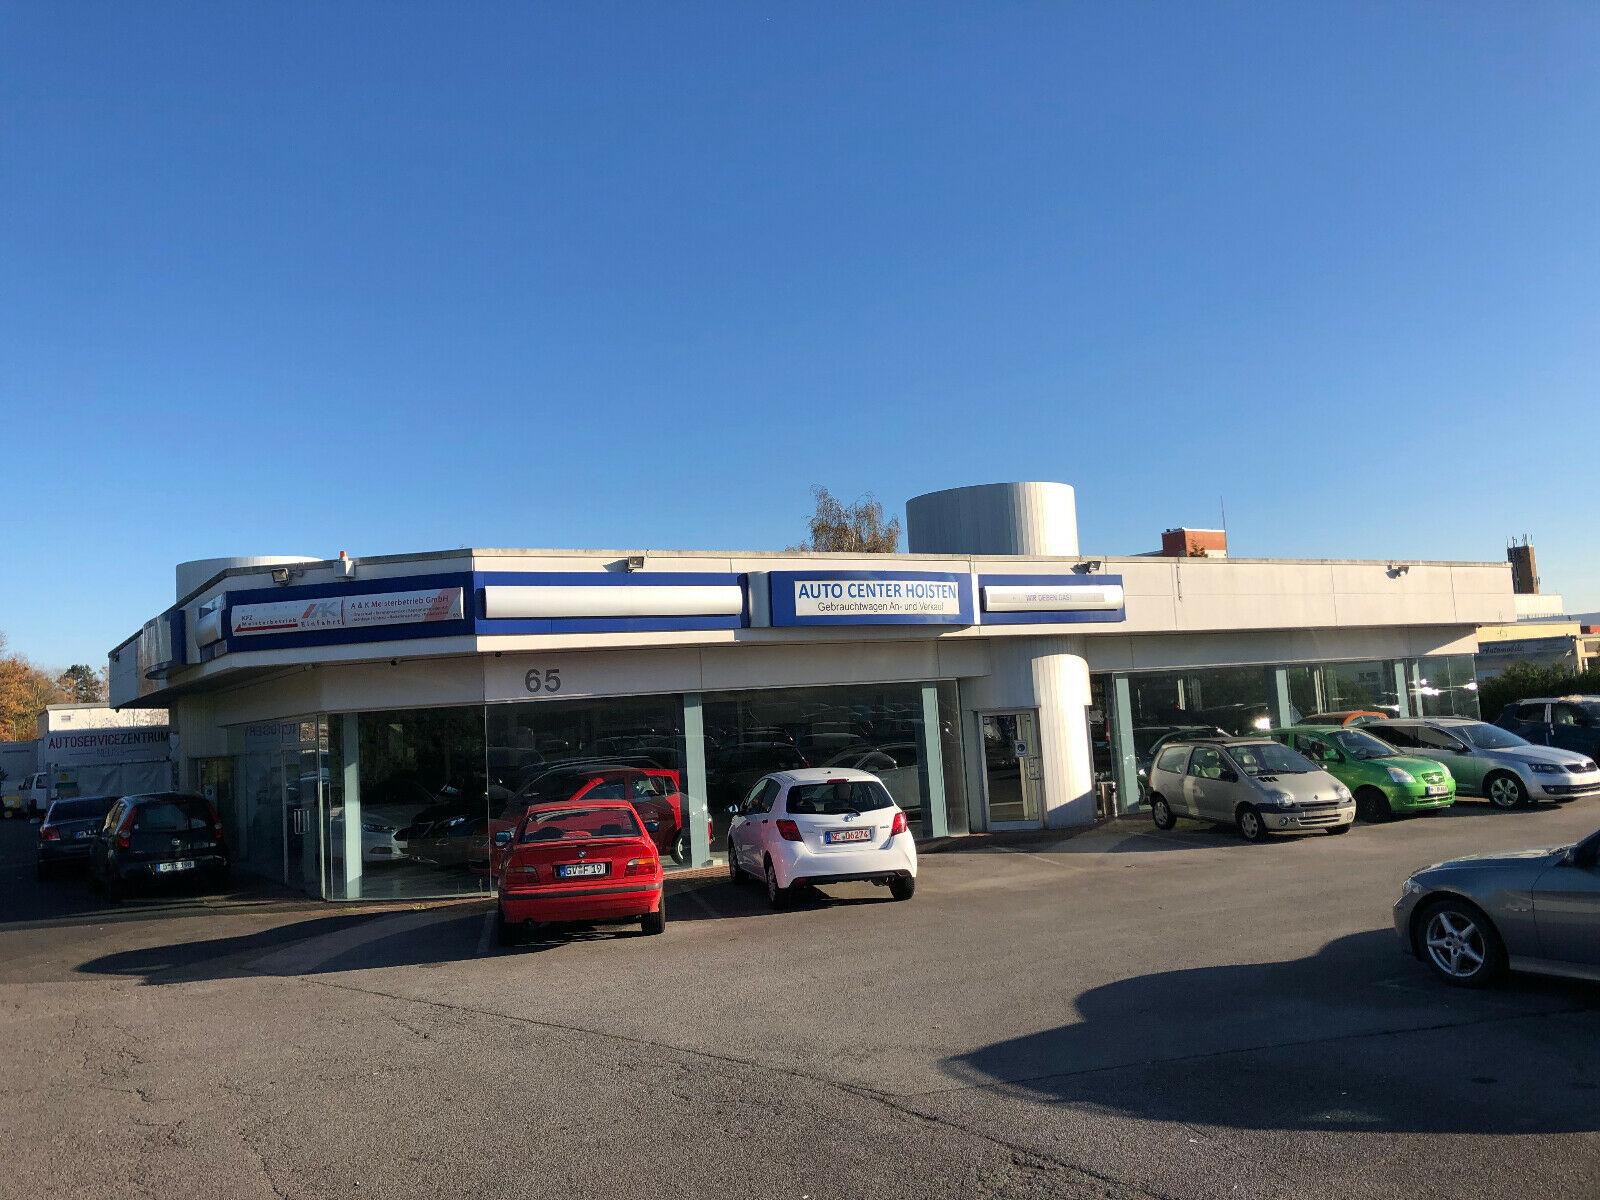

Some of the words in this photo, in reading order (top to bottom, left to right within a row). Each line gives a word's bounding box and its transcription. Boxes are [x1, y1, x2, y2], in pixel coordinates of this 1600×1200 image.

[799, 583, 843, 599] AUTO
[847, 583, 902, 599] CENTER
[905, 583, 957, 599] HOISTEN
[351, 602, 357, 610] A
[364, 600, 370, 608] K
[371, 597, 424, 608] Meisterbetrieb
[425, 595, 449, 604] GmbH
[817, 601, 888, 613] Gebrauchtwagen
[889, 601, 902, 611] An-
[904, 601, 918, 611] und
[918, 601, 944, 612] Verkauf
[241, 617, 297, 627] Meisterbetrieb
[300, 619, 341, 628] Einfahrt
[525, 668, 561, 692] 65
[48, 731, 170, 750] AUTOSERVICEZENTRUM
